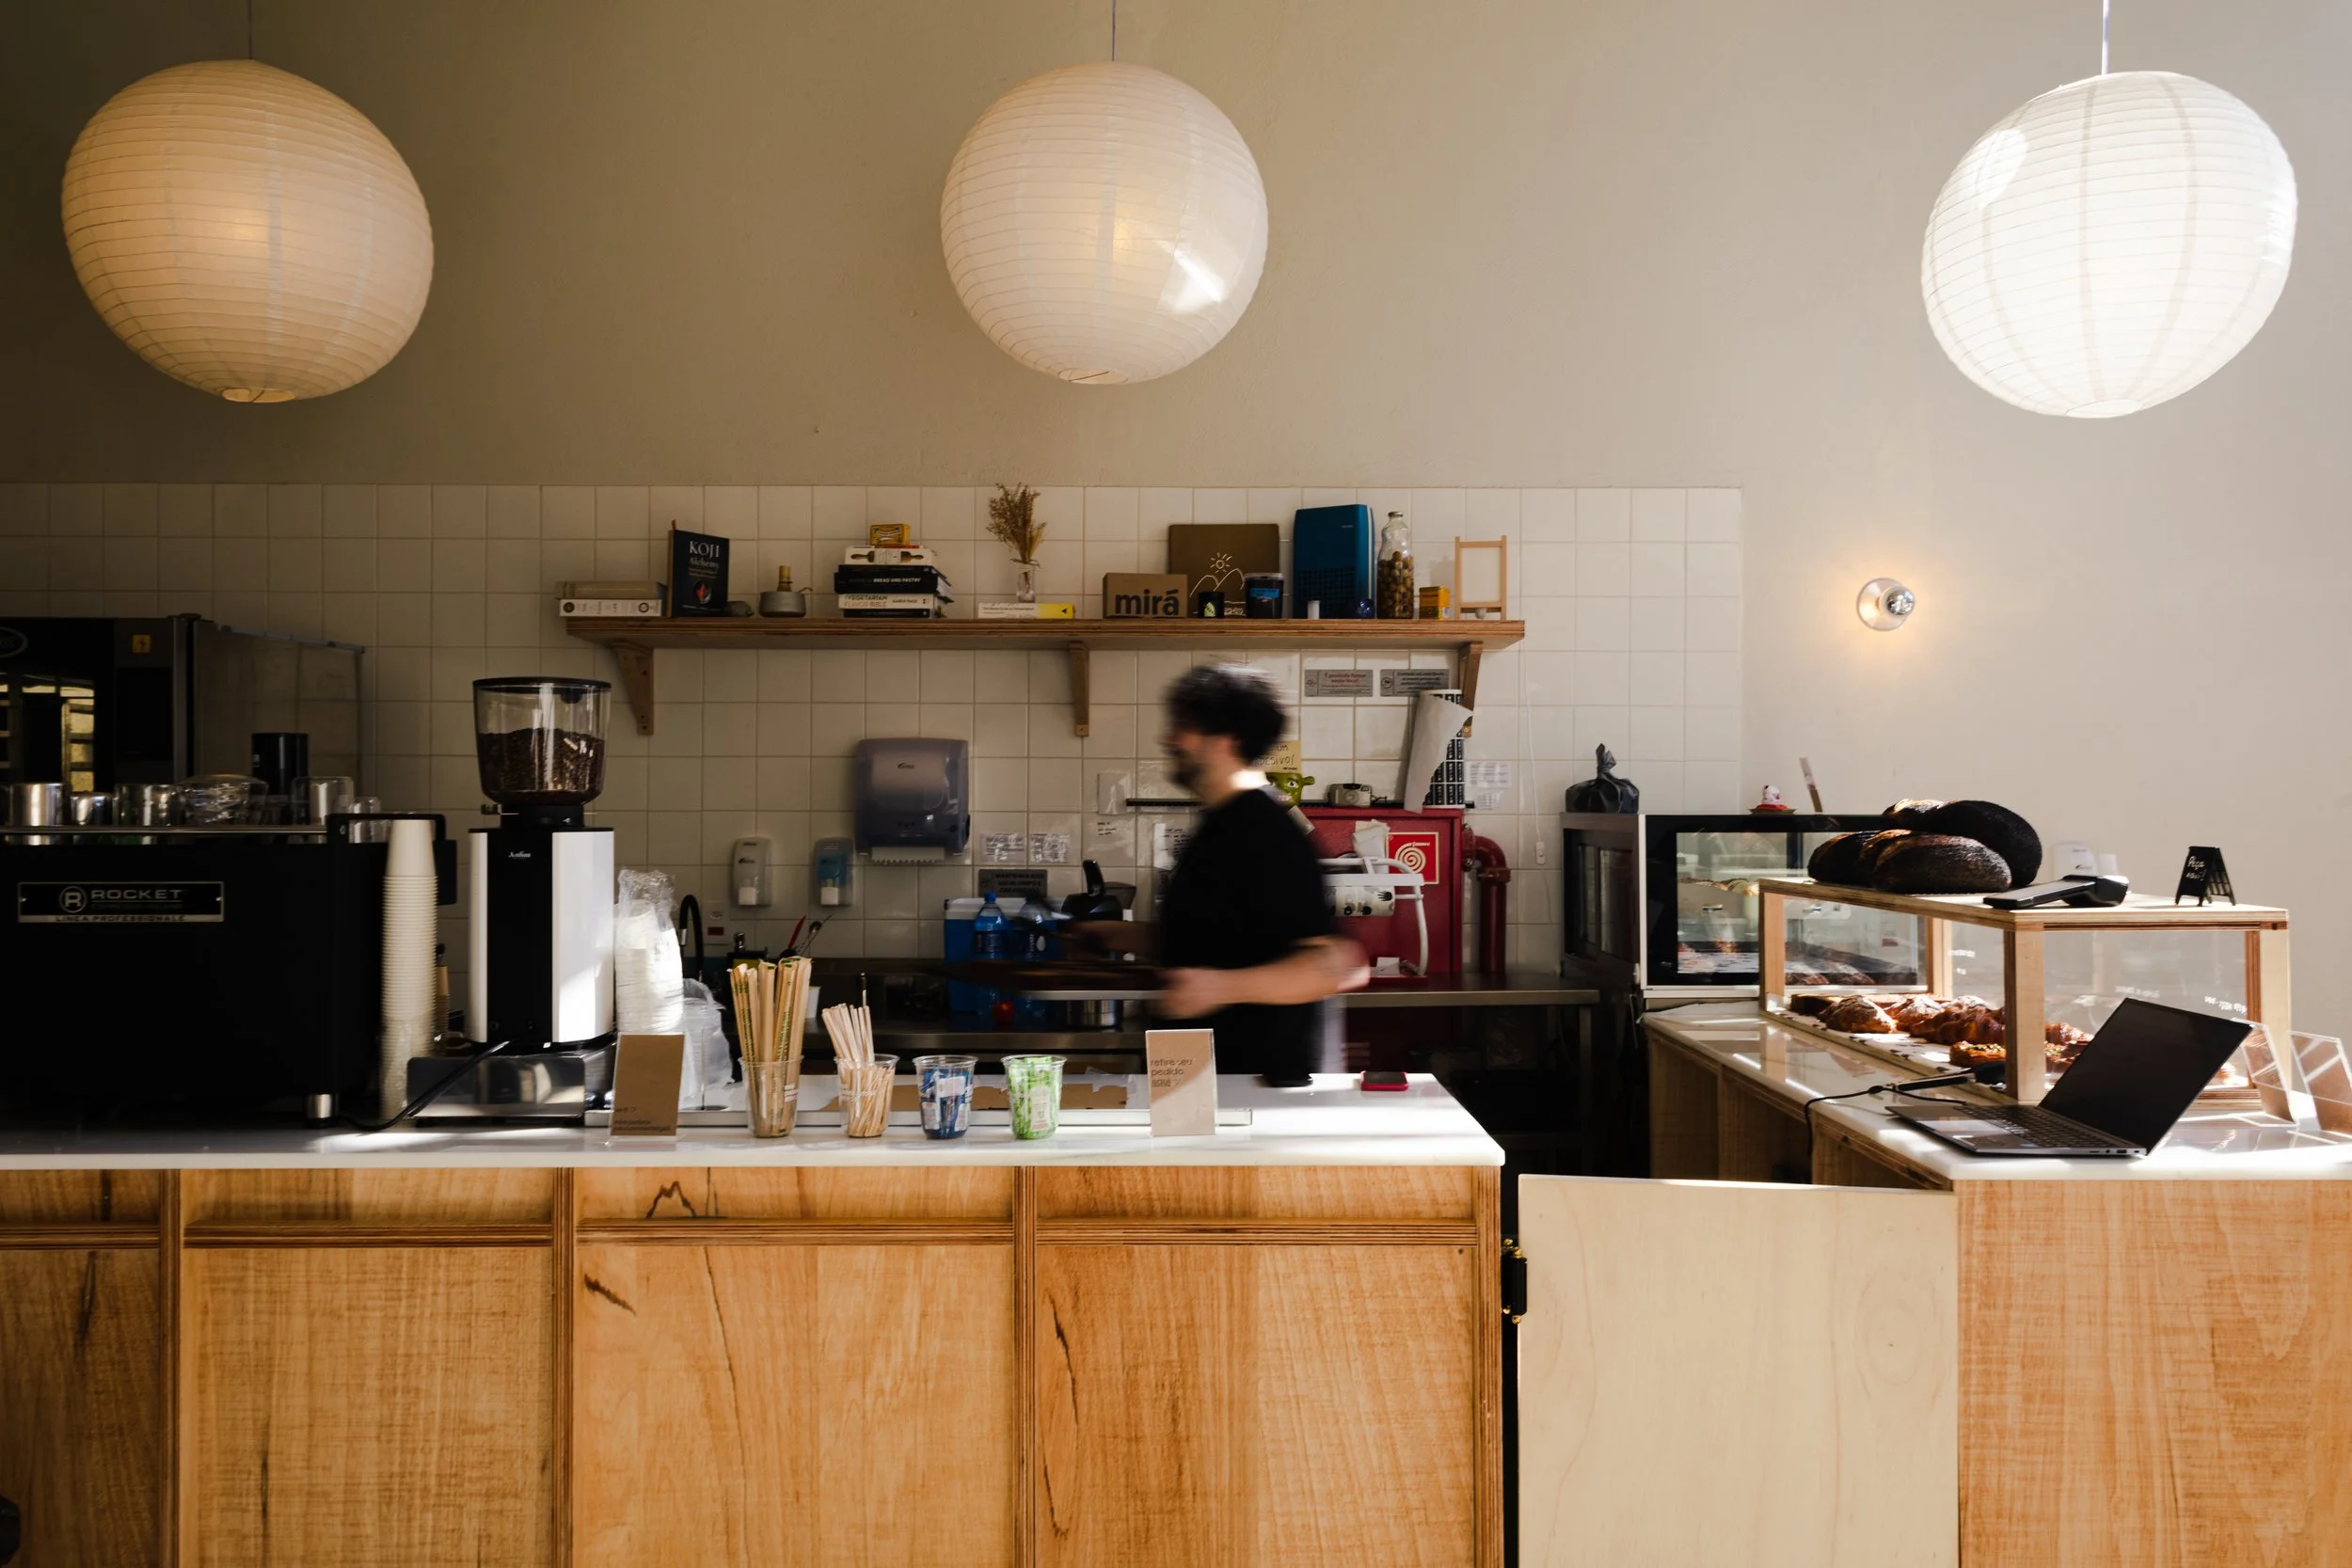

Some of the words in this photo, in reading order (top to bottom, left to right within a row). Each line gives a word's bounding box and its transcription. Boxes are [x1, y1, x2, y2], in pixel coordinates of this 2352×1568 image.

[689, 541, 720, 558] KOJI
[1115, 589, 1180, 615] mirá
[64, 891, 82, 909] R
[90, 889, 183, 900] ROCKET
[1152, 1068, 1184, 1077] pedido
[1152, 1078, 1171, 1086] aqui
